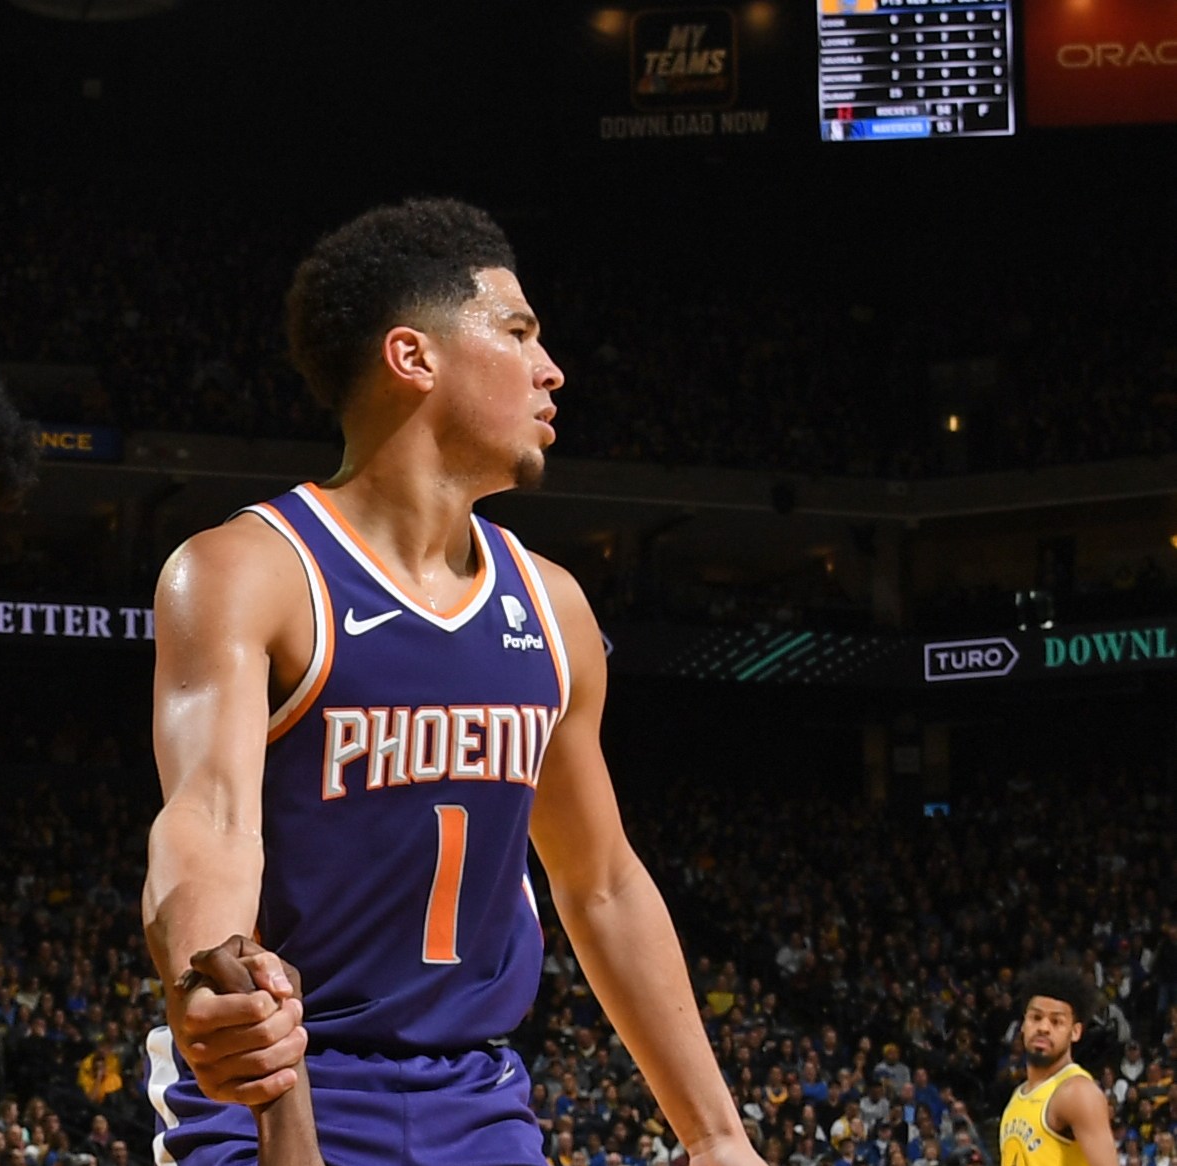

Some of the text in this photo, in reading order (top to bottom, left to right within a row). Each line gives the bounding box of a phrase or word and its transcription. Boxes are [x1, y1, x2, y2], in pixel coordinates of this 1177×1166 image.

[668, 23, 708, 50] MY
[644, 49, 727, 75] TEAMS
[1056, 41, 1177, 68] ORAC
[600, 110, 770, 139] DOWNLOAD NOW
[503, 633, 544, 651] PayPal
[1044, 627, 1177, 669] DOWNL
[935, 648, 1003, 672] TURO
[422, 804, 469, 964] 1
